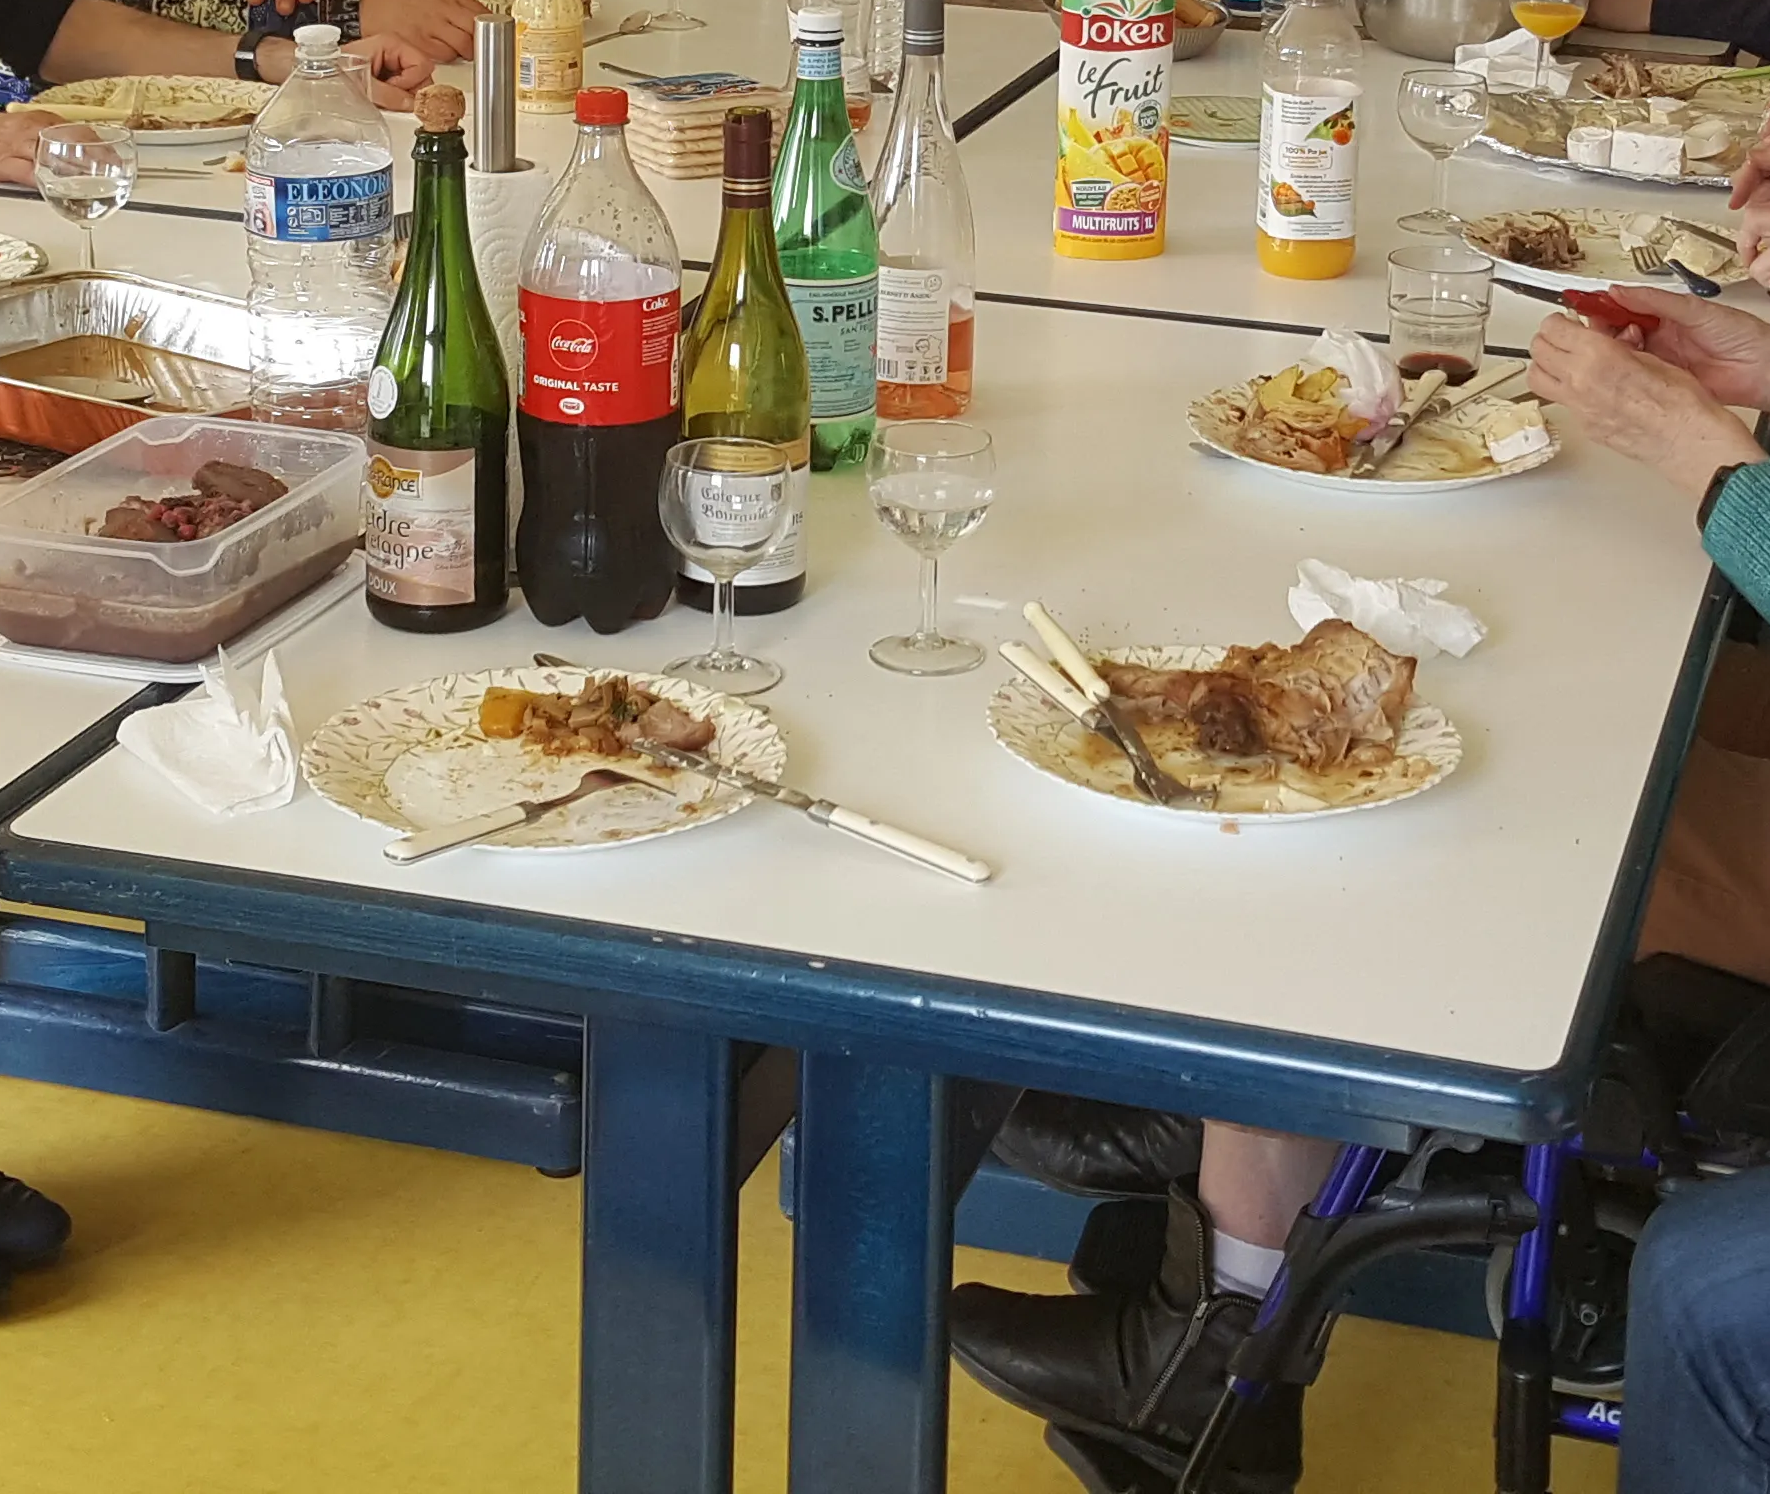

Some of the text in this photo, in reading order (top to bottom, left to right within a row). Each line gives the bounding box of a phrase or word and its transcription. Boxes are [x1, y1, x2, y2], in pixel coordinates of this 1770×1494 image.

[1078, 16, 1166, 46] JOKER
[1072, 214, 1140, 231] MULTIFRUITS
[642, 296, 670, 312] Coke
[551, 335, 595, 353] Coca-Cola
[533, 374, 619, 392] ORIGINAL TASTE
[370, 534, 434, 570] etagne
[1587, 1400, 1623, 1425] Ac
